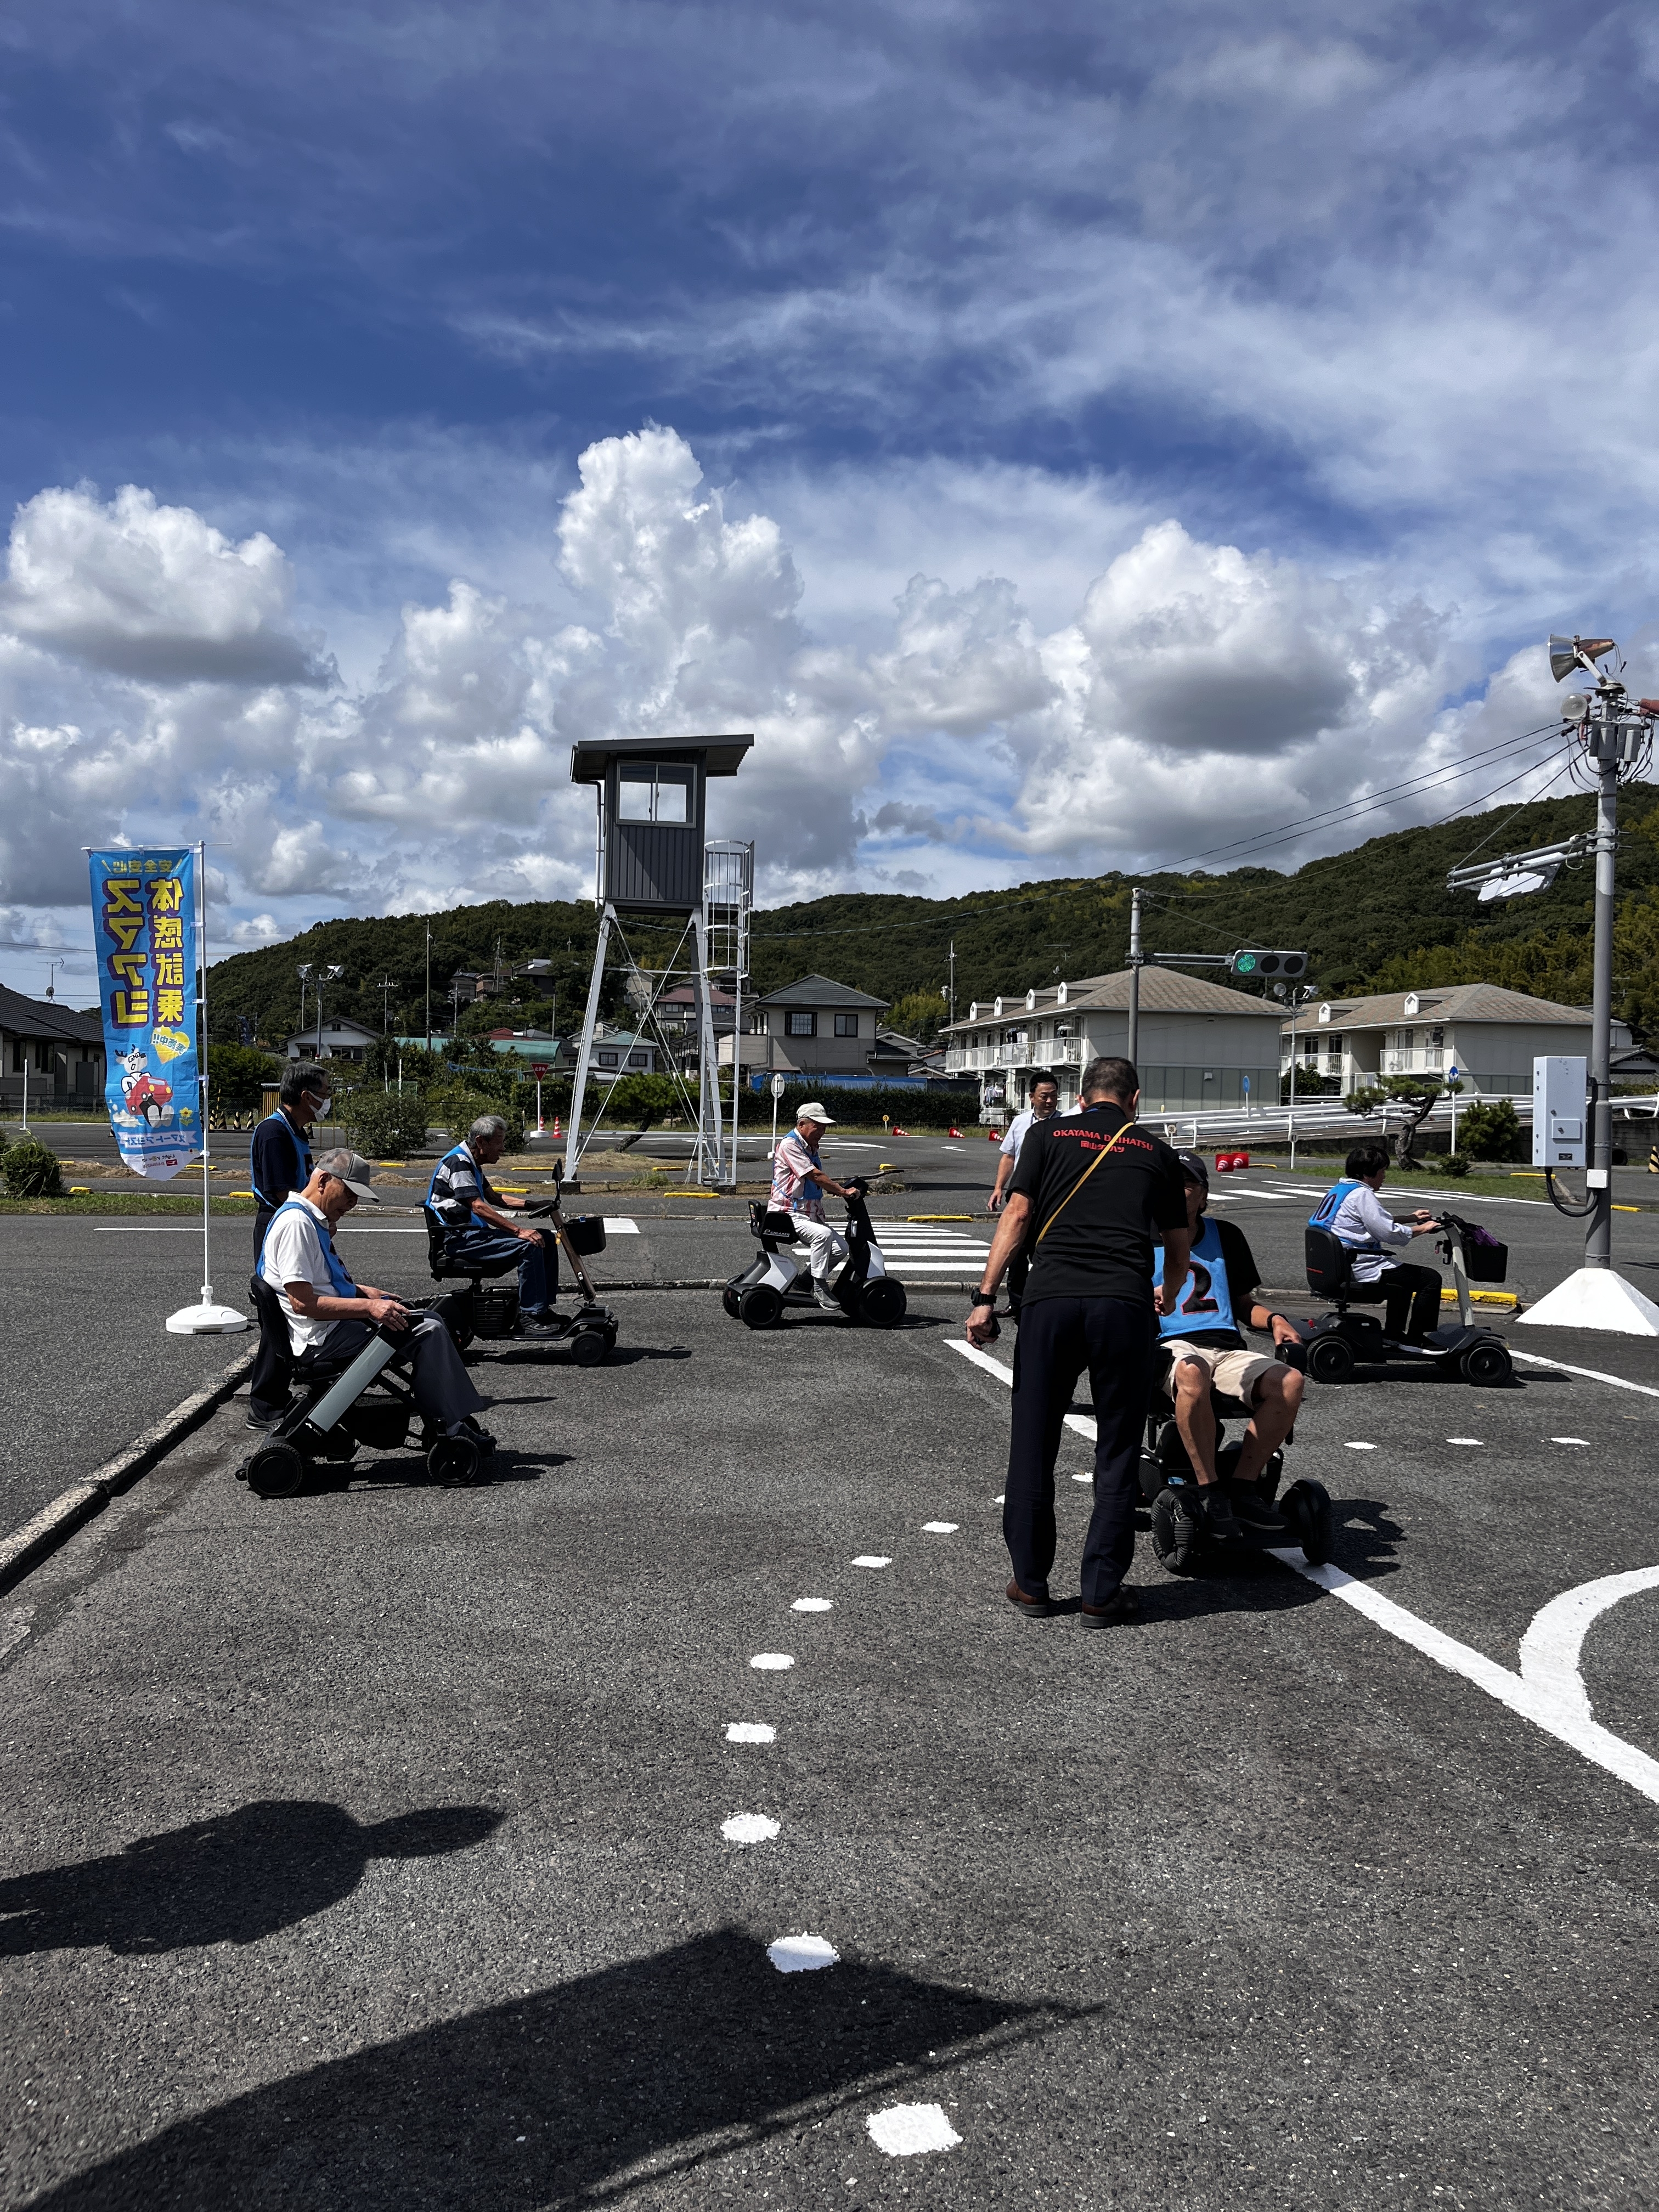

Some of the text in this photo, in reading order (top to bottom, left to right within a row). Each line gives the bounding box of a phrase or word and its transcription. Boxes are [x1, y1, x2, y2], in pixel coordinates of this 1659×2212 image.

[1053, 1129, 1153, 1151] OKAYAMA DIHATSU
[1080, 1140, 1125, 1153] 岡山ダハツ
[1180, 1261, 1219, 1316] 2
